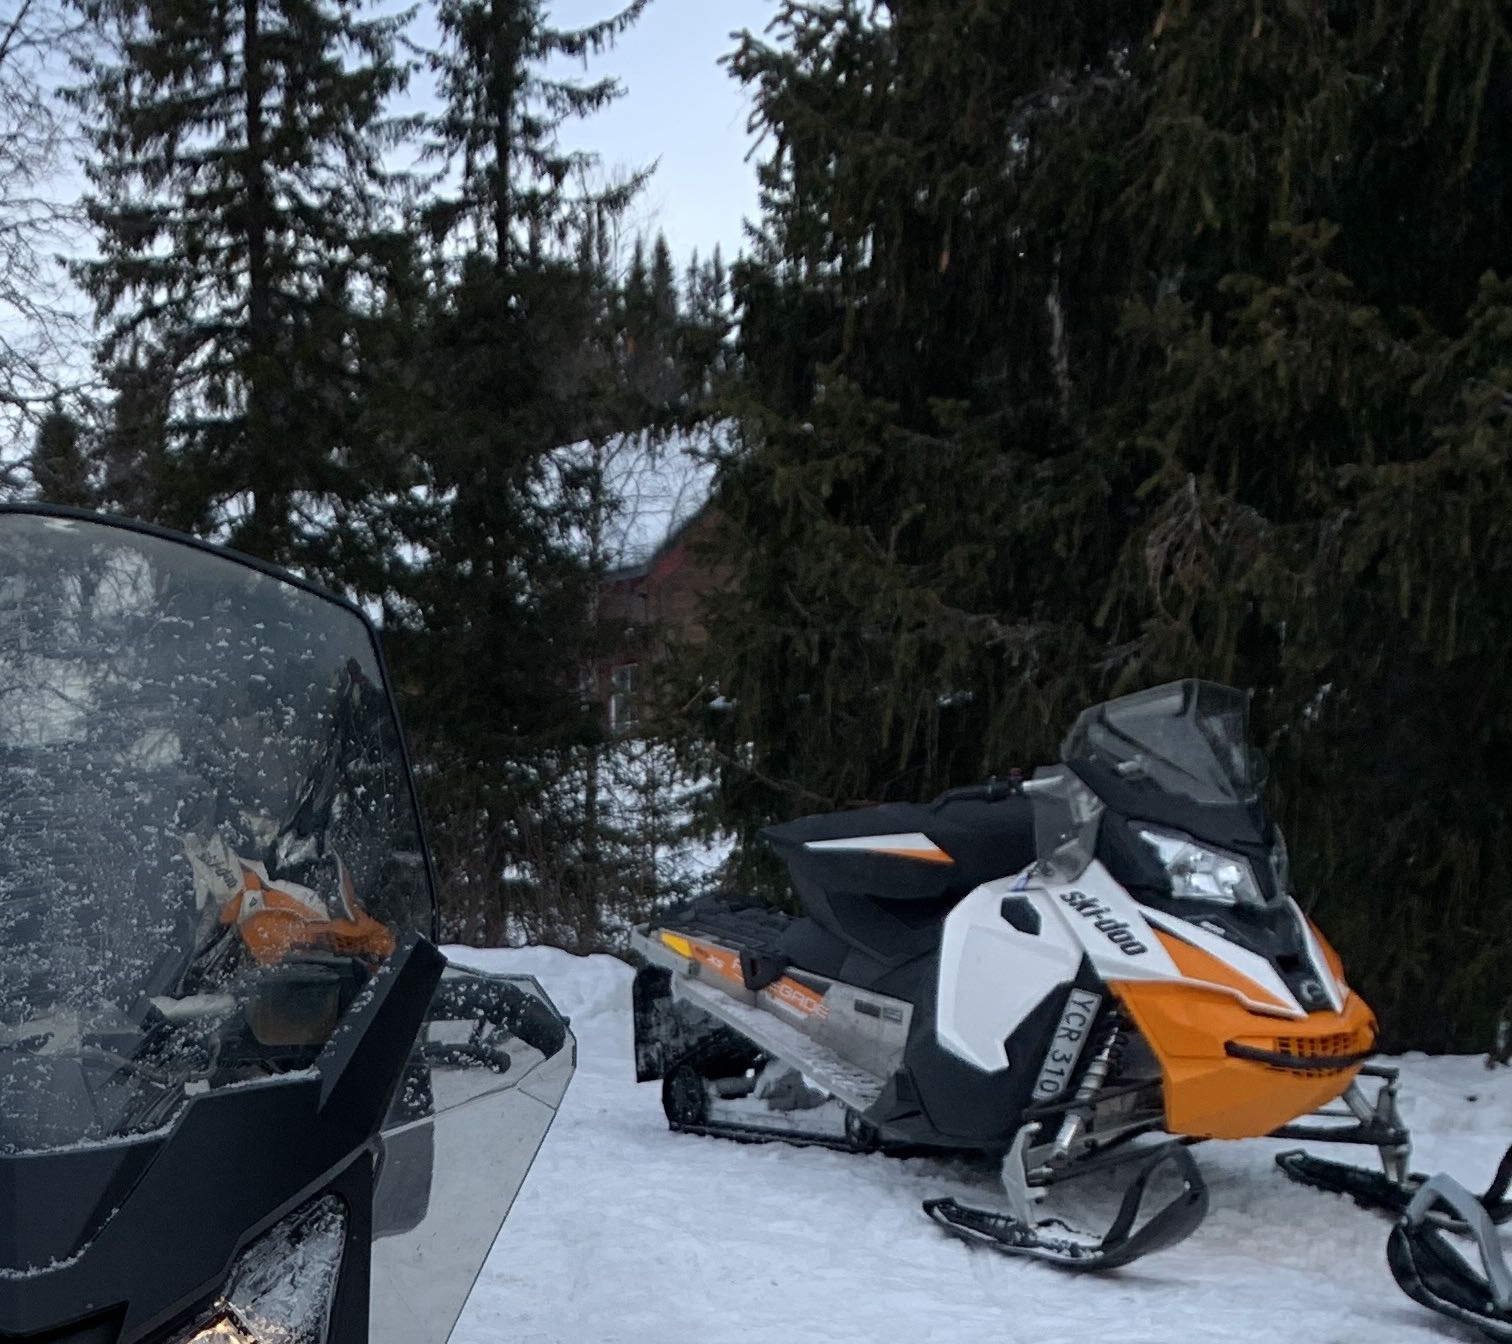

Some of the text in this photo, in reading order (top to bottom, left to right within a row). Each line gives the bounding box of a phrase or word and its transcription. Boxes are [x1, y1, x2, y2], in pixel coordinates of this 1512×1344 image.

[1060, 890, 1148, 956] ski-doo
[1039, 997, 1095, 1093] YCR 310
